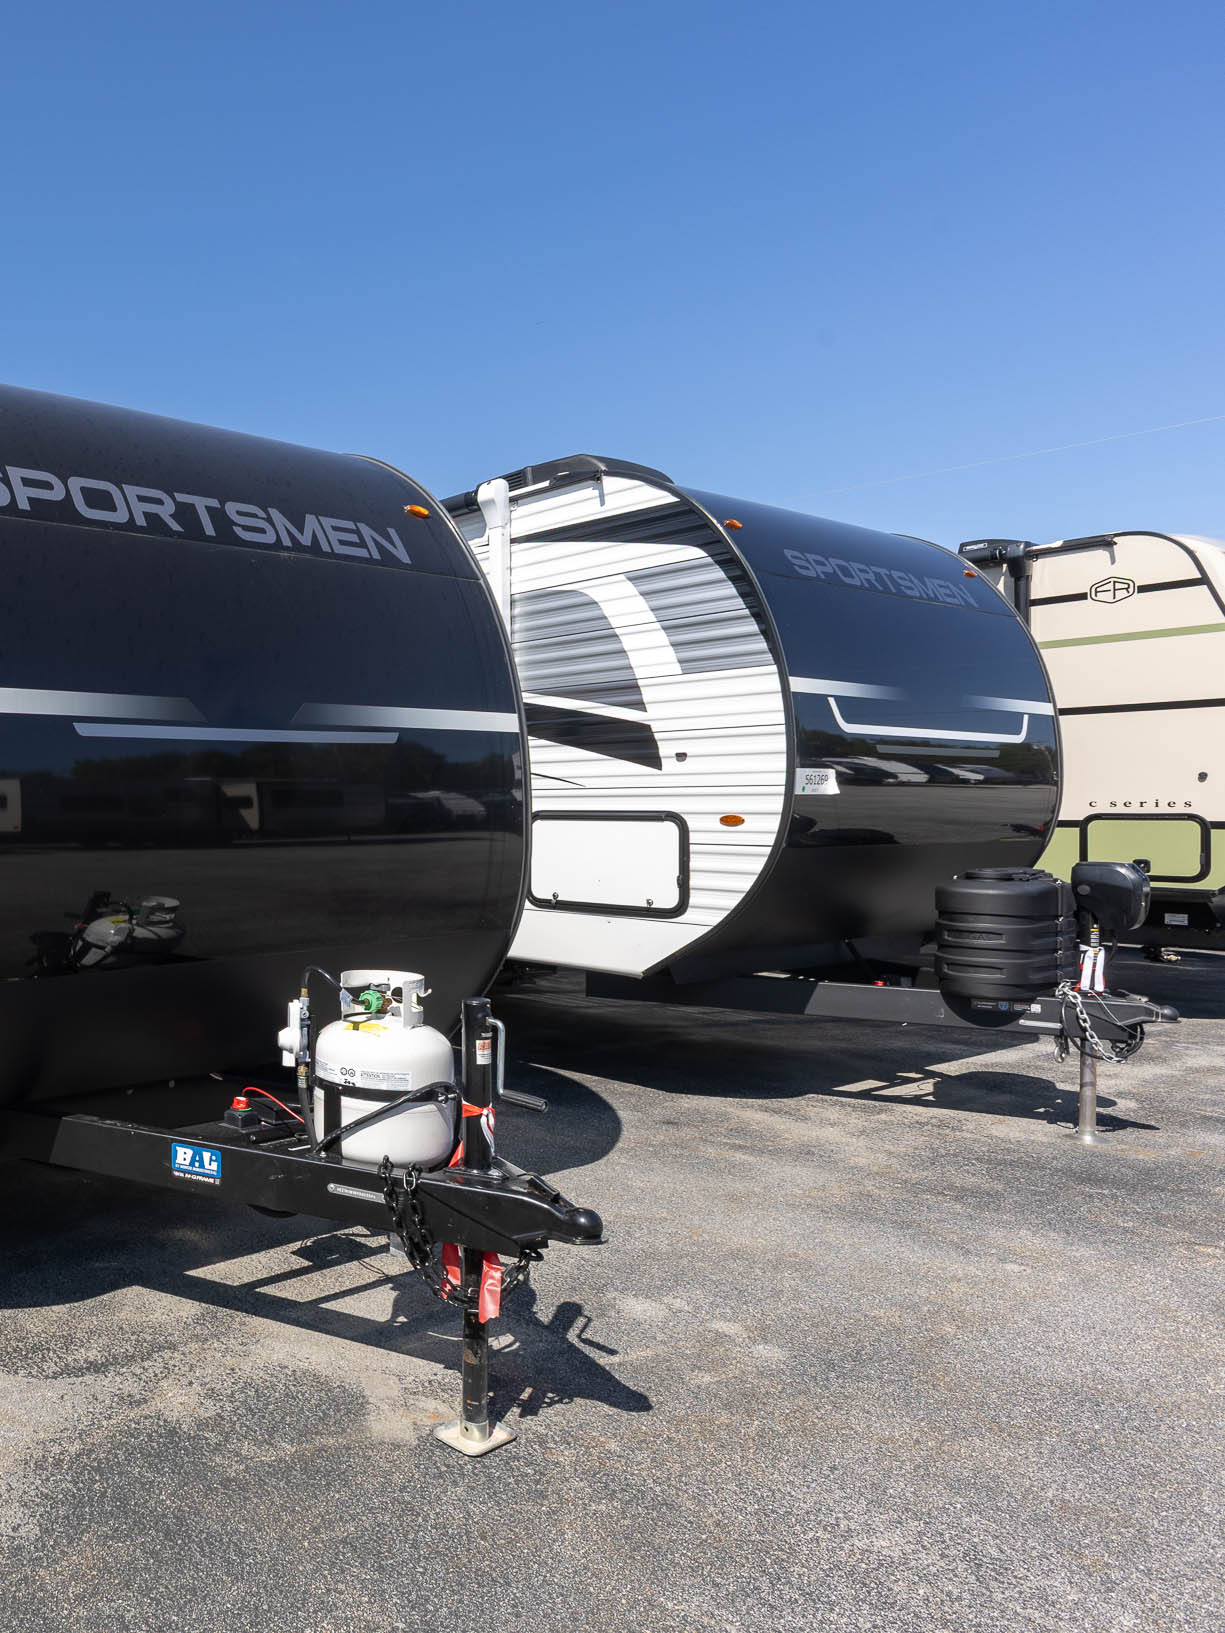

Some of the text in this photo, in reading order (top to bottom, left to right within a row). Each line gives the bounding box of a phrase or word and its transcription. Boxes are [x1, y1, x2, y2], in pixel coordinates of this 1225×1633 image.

[783, 549, 979, 608] SPORTSMEN
[1109, 798, 1193, 808] series
[175, 1145, 218, 1171] BAL
